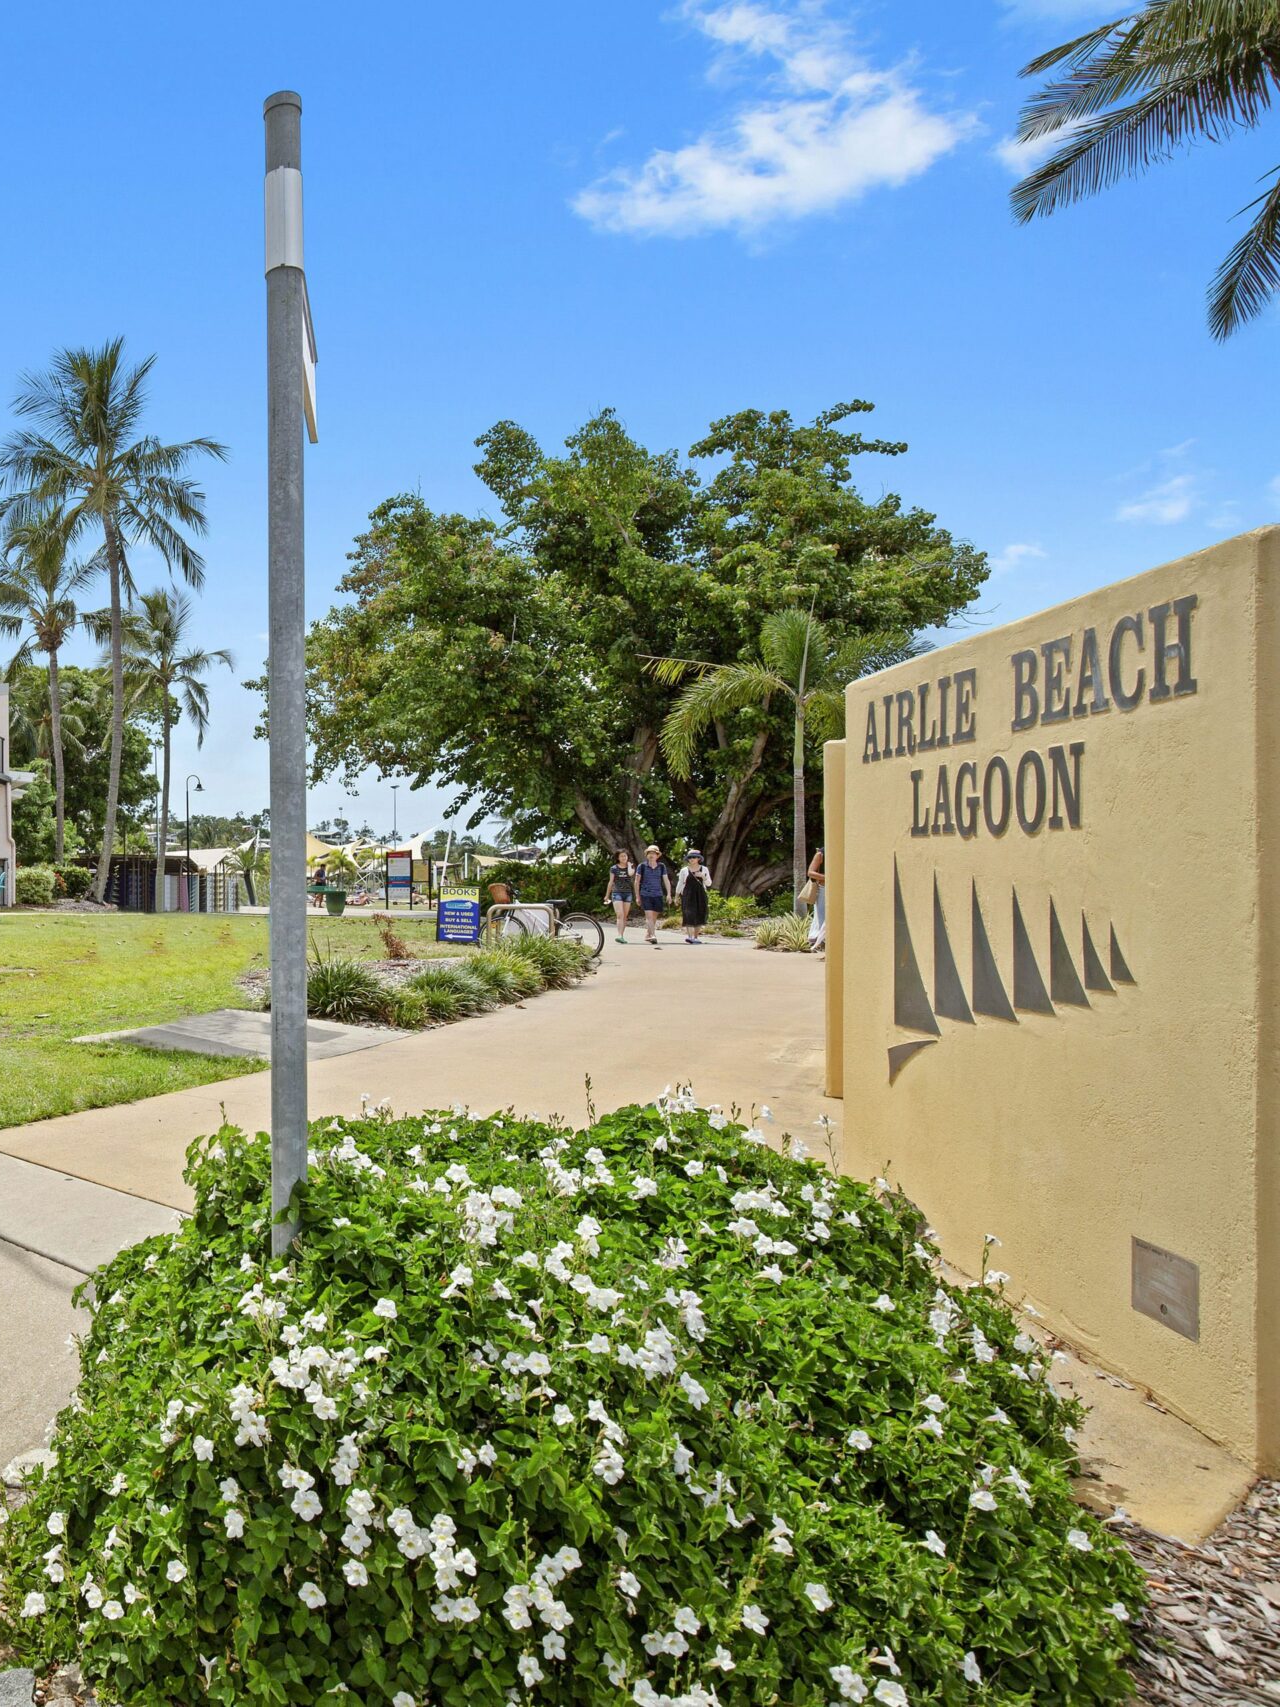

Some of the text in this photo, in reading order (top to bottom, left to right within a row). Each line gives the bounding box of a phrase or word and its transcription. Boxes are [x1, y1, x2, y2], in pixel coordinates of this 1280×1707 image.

[862, 593, 1198, 764] AIRLIE BEACH
[910, 741, 1086, 839] LAGOON
[443, 888, 476, 896] BOOKS
